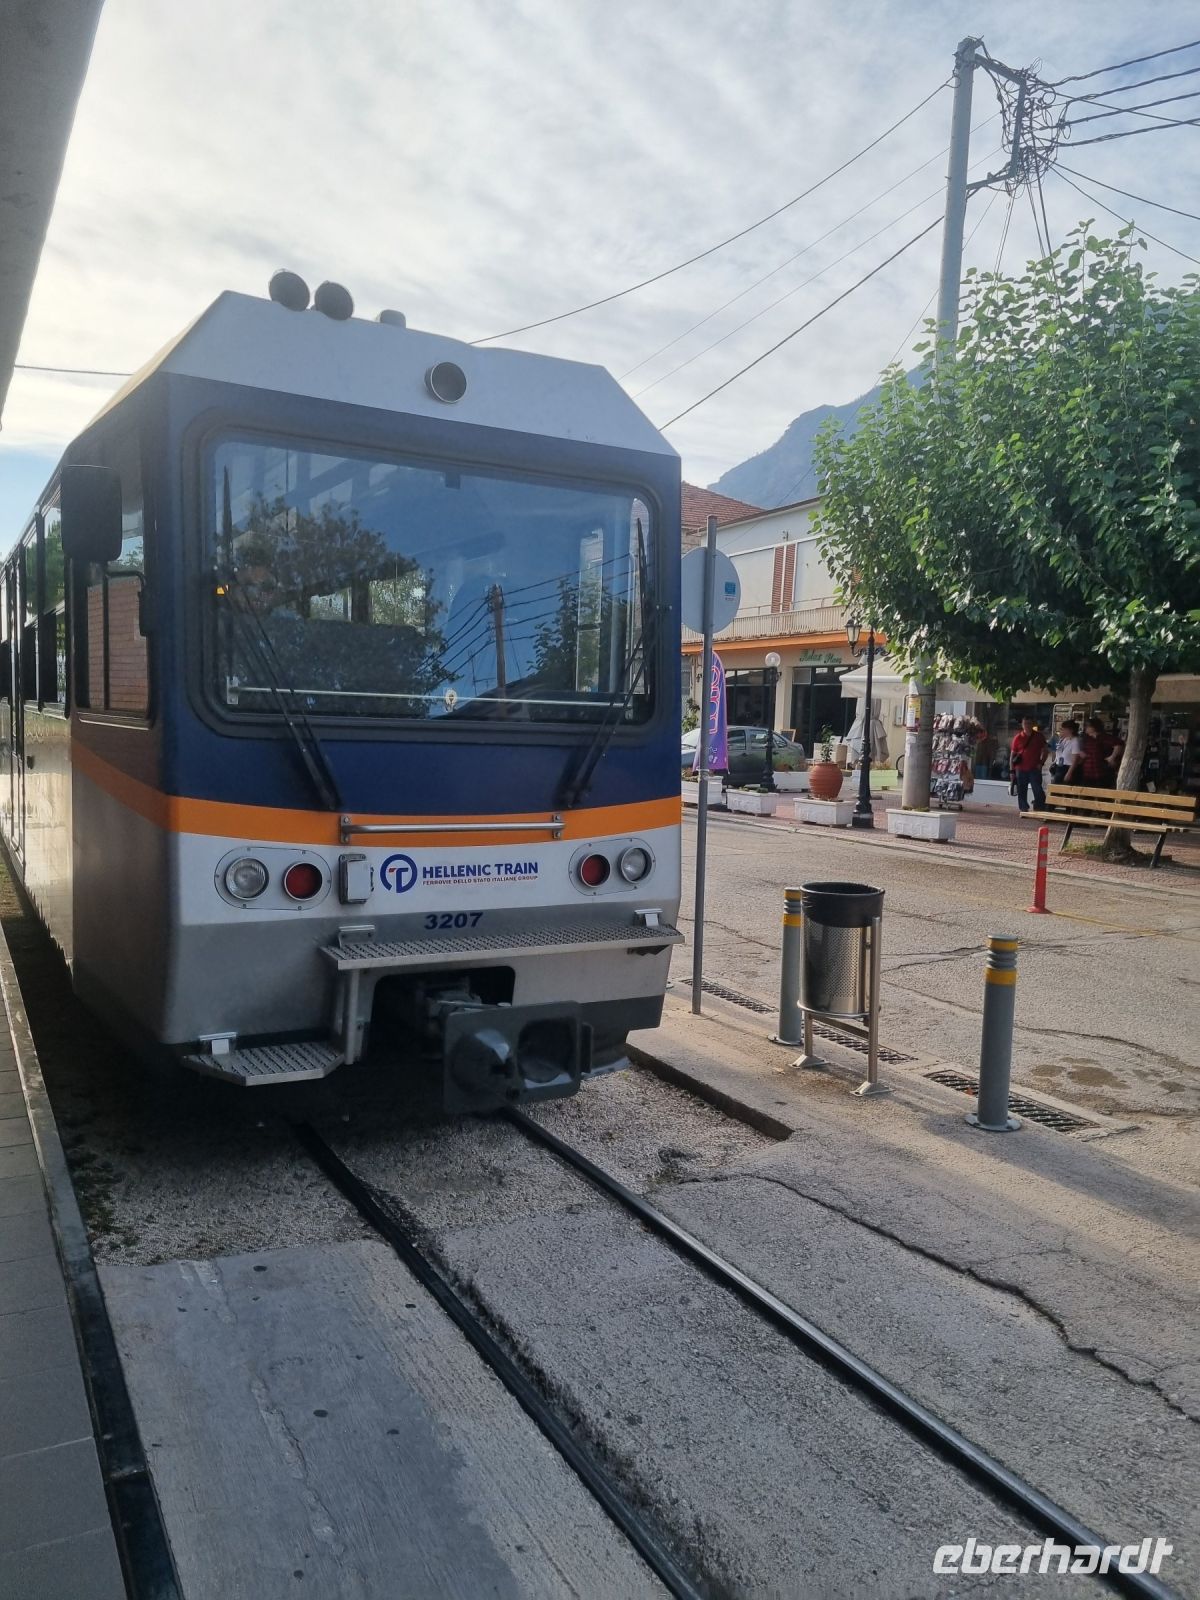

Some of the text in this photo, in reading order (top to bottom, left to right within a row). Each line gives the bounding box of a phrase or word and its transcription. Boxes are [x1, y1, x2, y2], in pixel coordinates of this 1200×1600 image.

[422, 861, 538, 879] HELLENIC TRAIN
[424, 912, 483, 930] 3207
